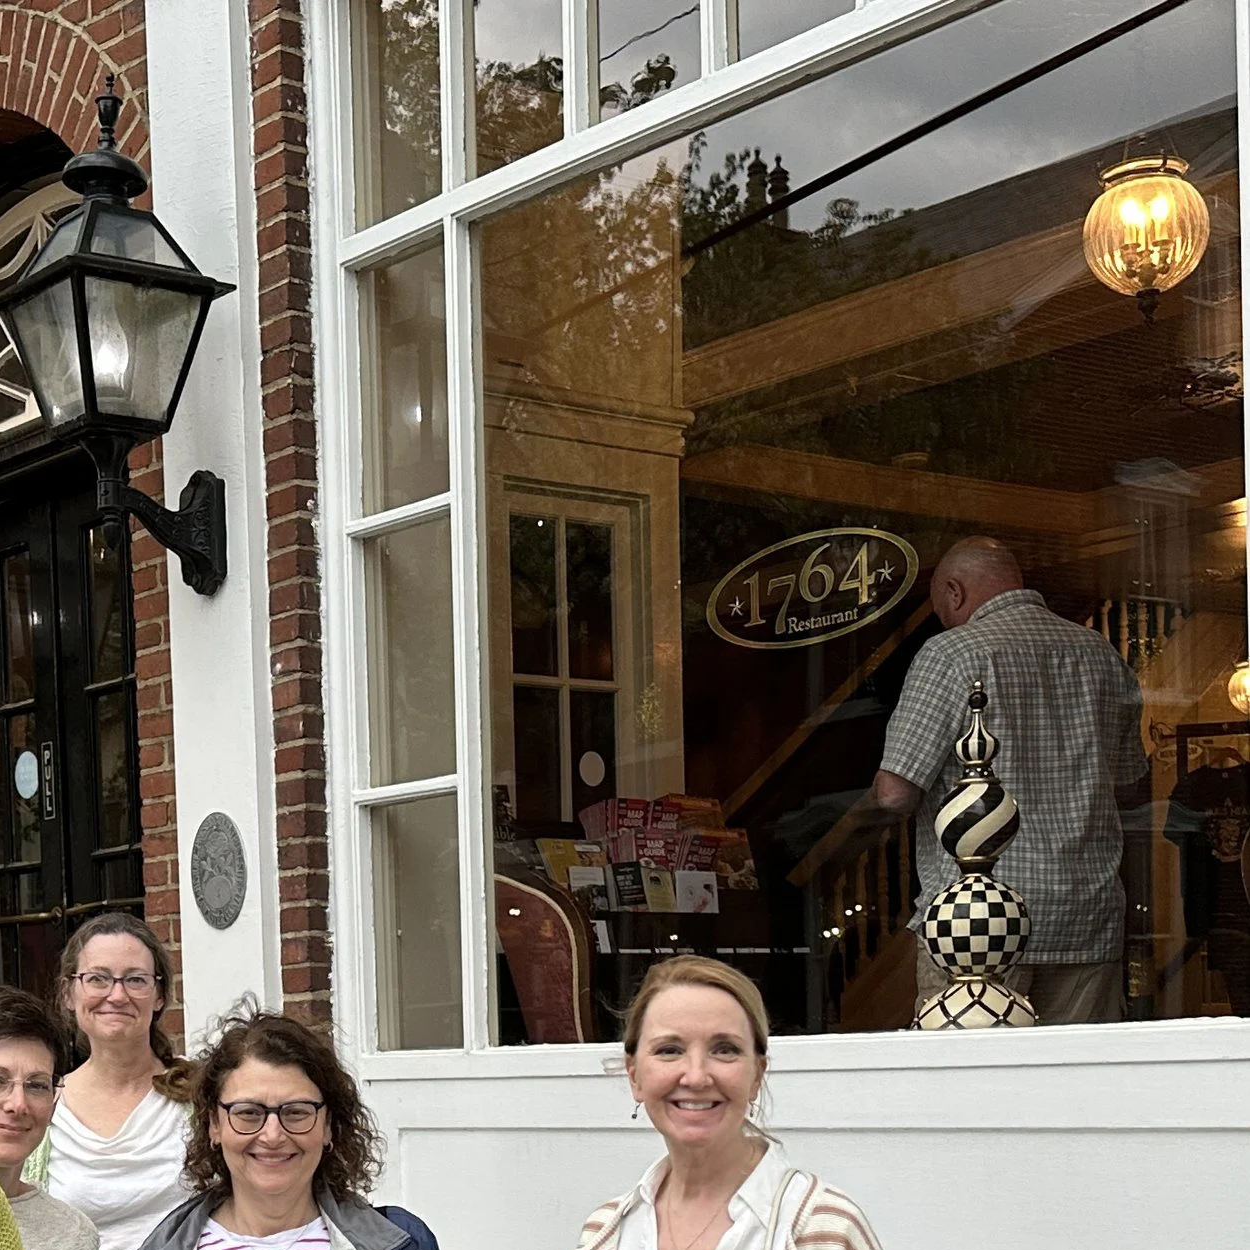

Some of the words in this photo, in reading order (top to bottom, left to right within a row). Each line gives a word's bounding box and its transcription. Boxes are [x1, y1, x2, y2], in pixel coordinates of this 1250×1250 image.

[743, 541, 877, 635] 1764
[787, 607, 859, 635] Restaurant
[44, 750, 53, 811] PULL
[627, 810, 645, 819] MAP
[661, 812, 679, 821] MAP
[623, 818, 644, 828] GUIDE
[646, 840, 665, 849] MAP
[643, 848, 666, 857] GUIDE
